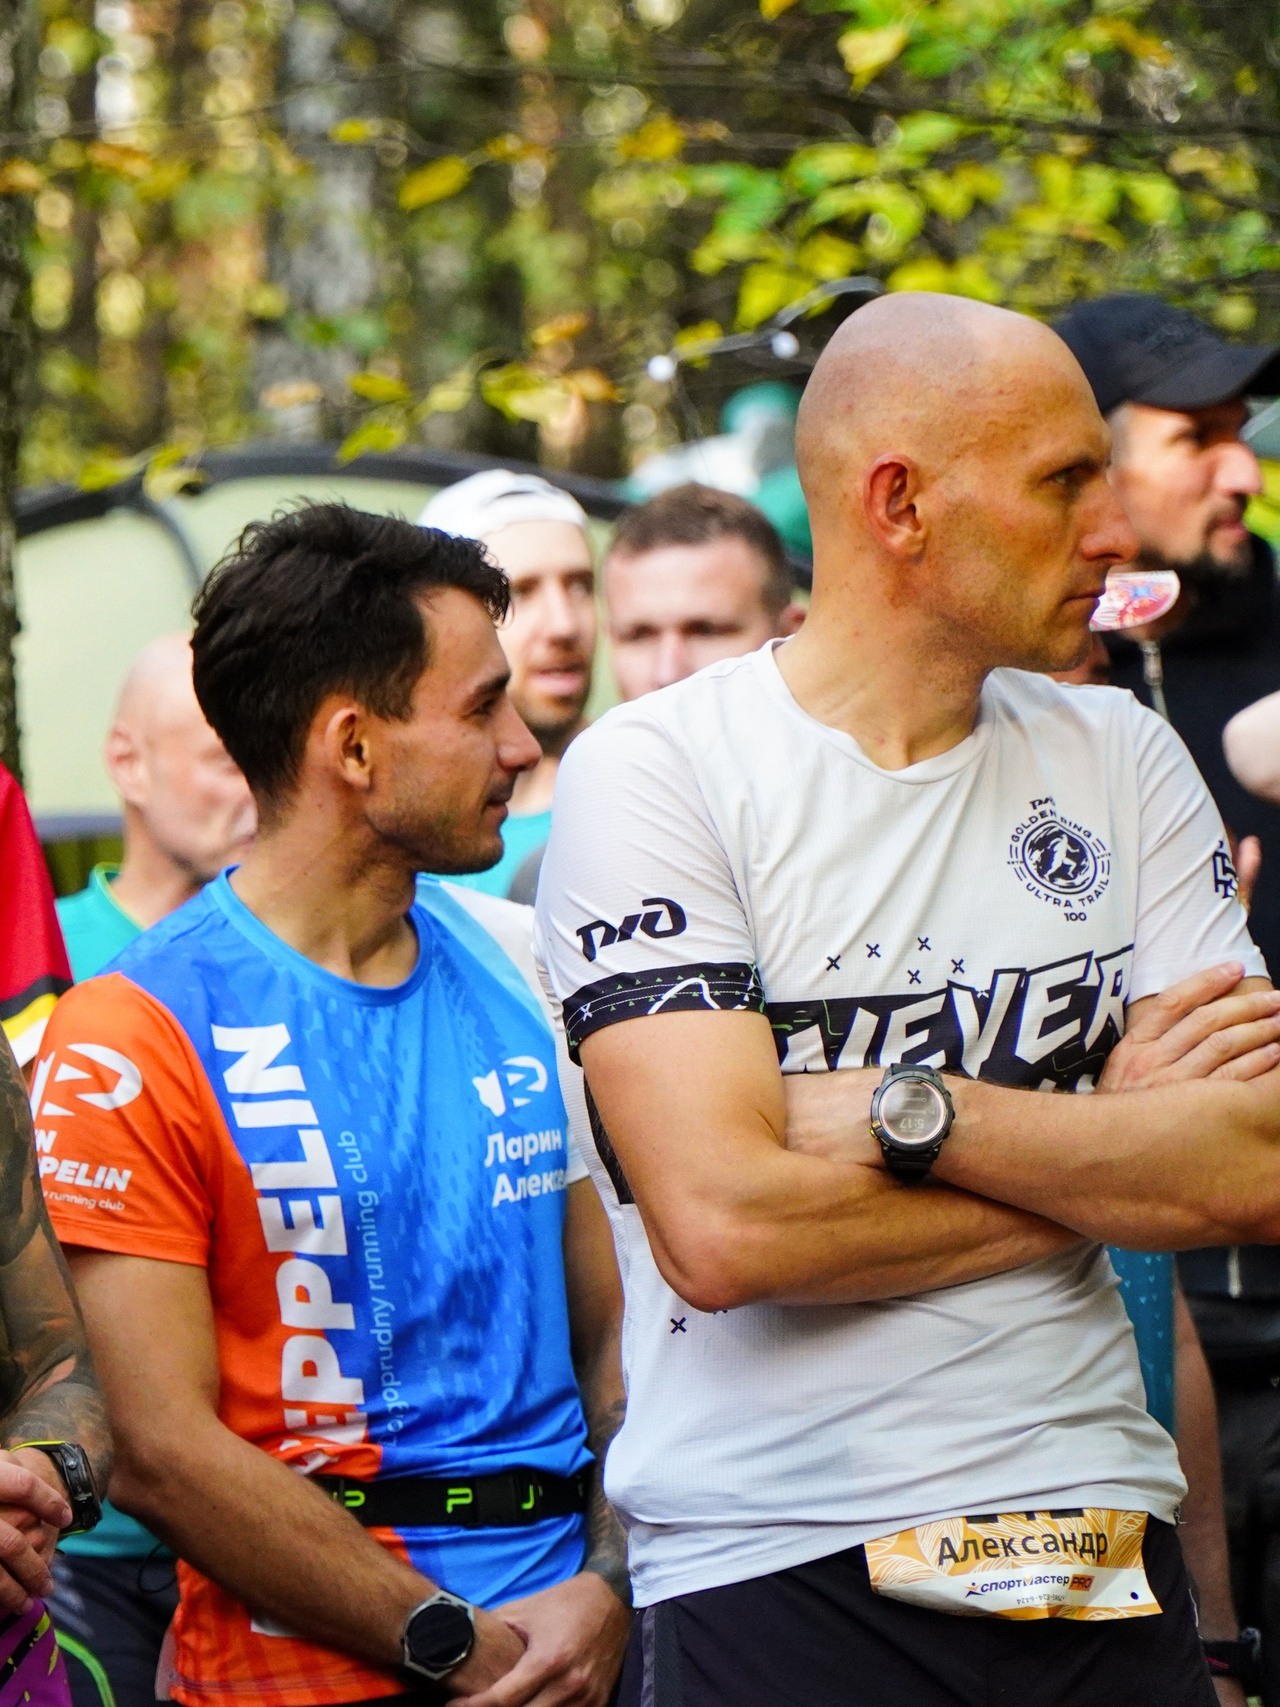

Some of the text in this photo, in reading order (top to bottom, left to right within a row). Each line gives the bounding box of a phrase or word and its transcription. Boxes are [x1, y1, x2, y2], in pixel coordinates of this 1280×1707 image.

[1026, 878, 1109, 908] ULTRA TRAIL
[1064, 911, 1087, 922] 100
[337, 1130, 369, 1184] club
[484, 1128, 562, 1168] Ларин
[38, 1155, 132, 1192] PELIN
[354, 1190, 387, 1290] running
[938, 1532, 1108, 1566] Александр
